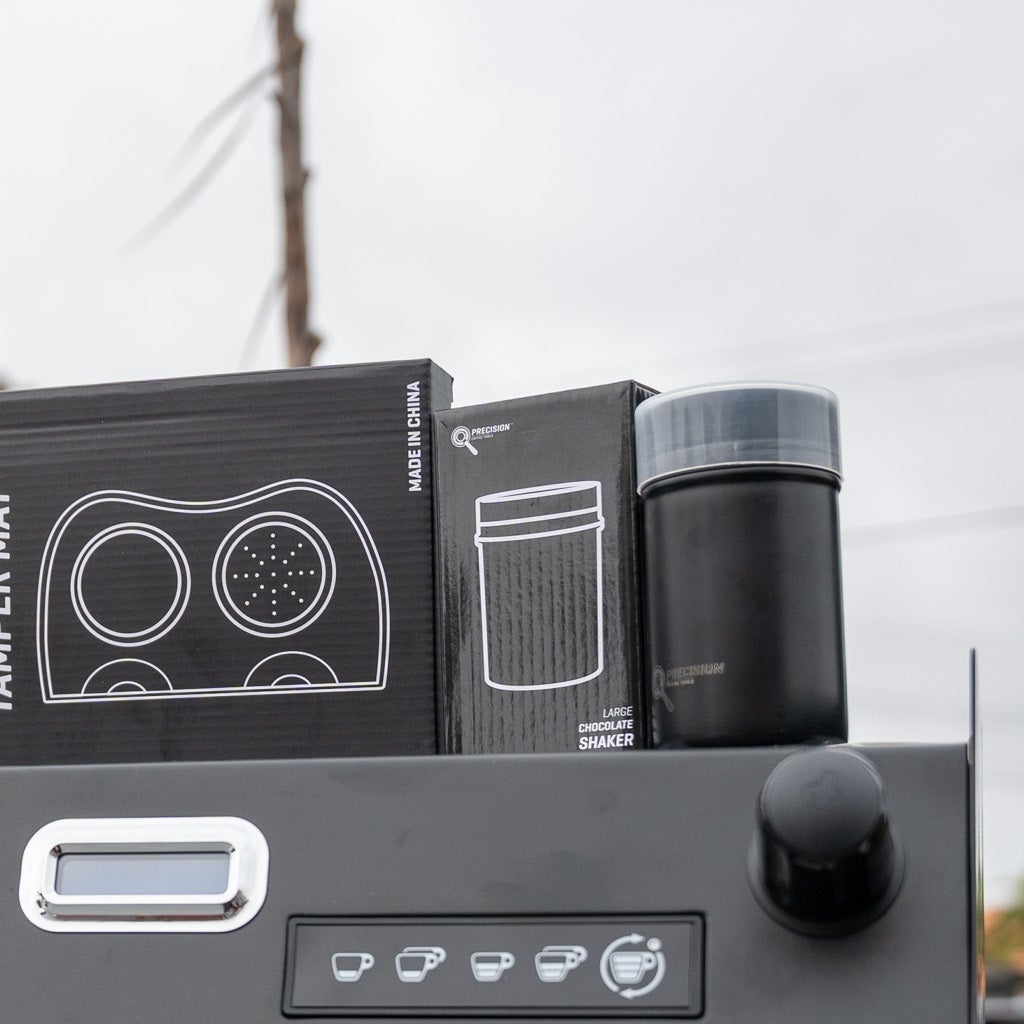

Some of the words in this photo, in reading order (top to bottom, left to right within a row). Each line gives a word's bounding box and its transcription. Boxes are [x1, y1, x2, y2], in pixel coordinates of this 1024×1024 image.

[406, 380, 421, 428] CHINA
[407, 430, 421, 447] IN
[407, 450, 422, 492] MADE
[602, 706, 634, 718] LARGE
[578, 719, 634, 733] CHOCOLATE
[578, 732, 634, 750] SHAKER
